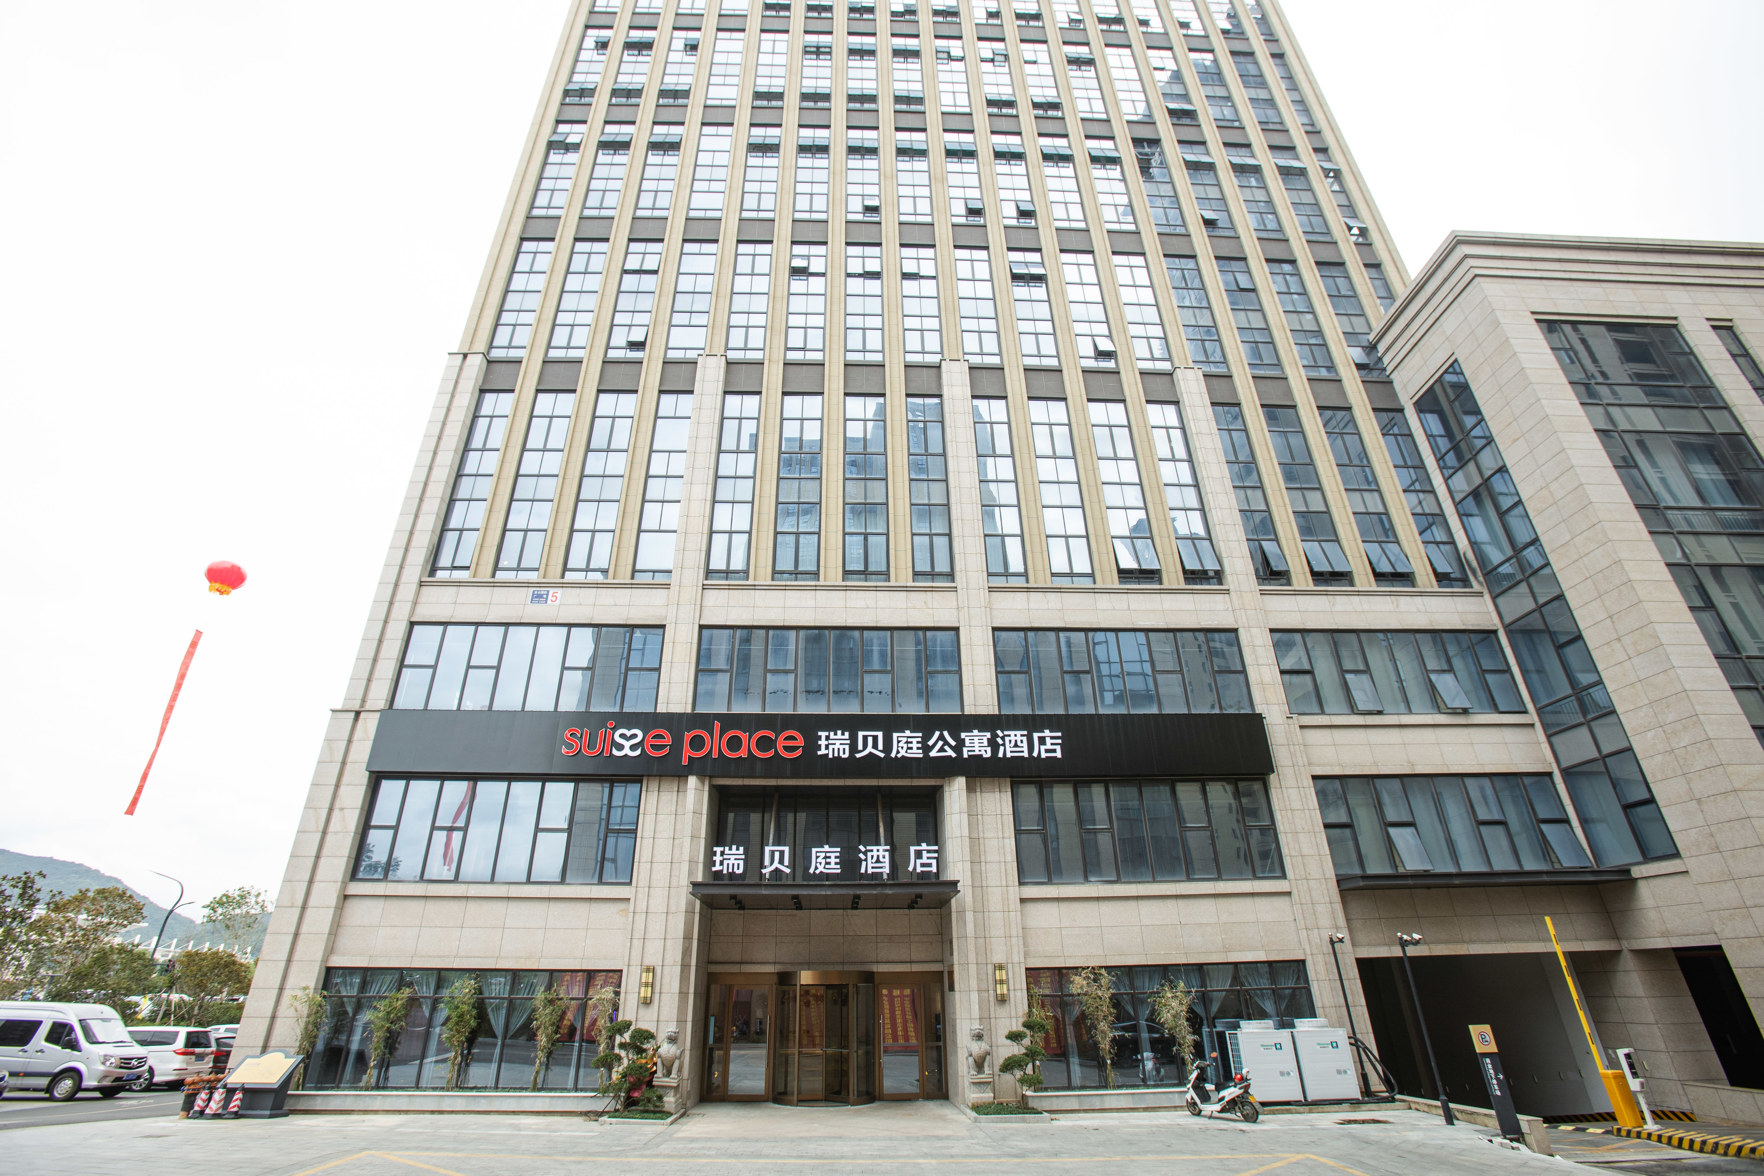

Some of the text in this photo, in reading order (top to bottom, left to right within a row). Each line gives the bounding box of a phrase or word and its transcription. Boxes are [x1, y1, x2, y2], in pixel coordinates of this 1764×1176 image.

[550, 591, 559, 603] 5
[682, 721, 804, 765] place
[817, 729, 1062, 758] 瑞贝庭公寓酒店
[711, 843, 939, 874] 瑞贝庭酒店
